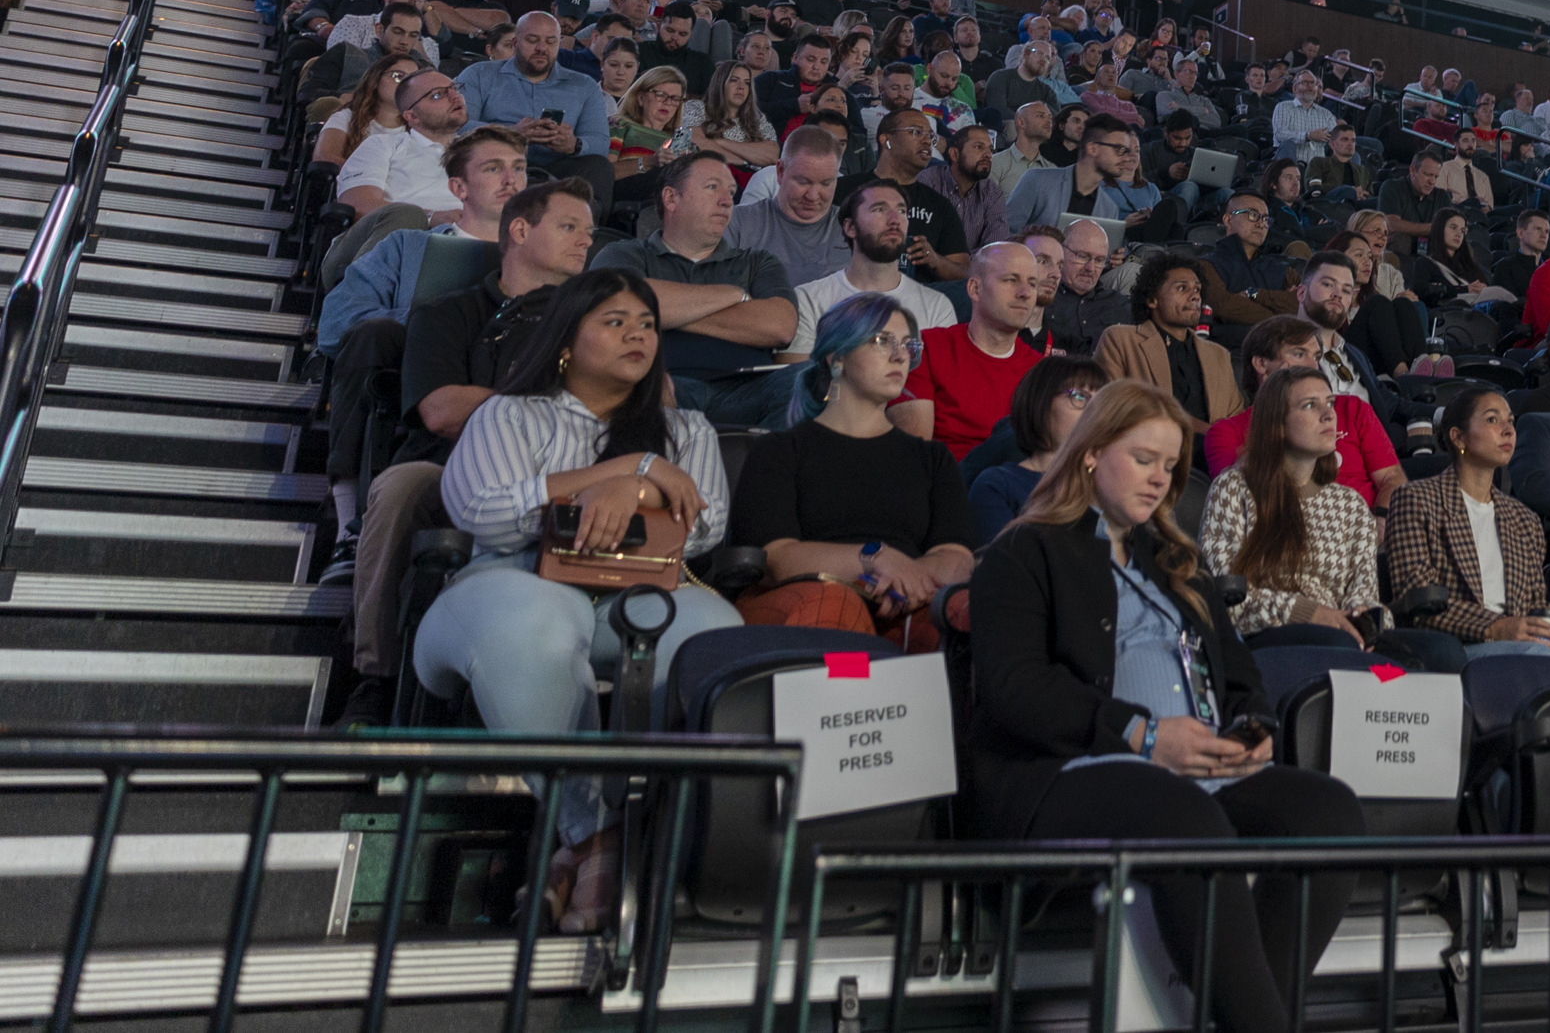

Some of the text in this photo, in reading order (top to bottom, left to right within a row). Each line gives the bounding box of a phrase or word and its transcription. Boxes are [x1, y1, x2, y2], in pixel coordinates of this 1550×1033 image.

[820, 704, 907, 730] RESERVED
[1365, 710, 1430, 725] RESERVED
[849, 730, 882, 748] FOR
[1384, 730, 1410, 744] FOR
[839, 751, 893, 773] PRESS
[1376, 750, 1416, 764] PRESS
